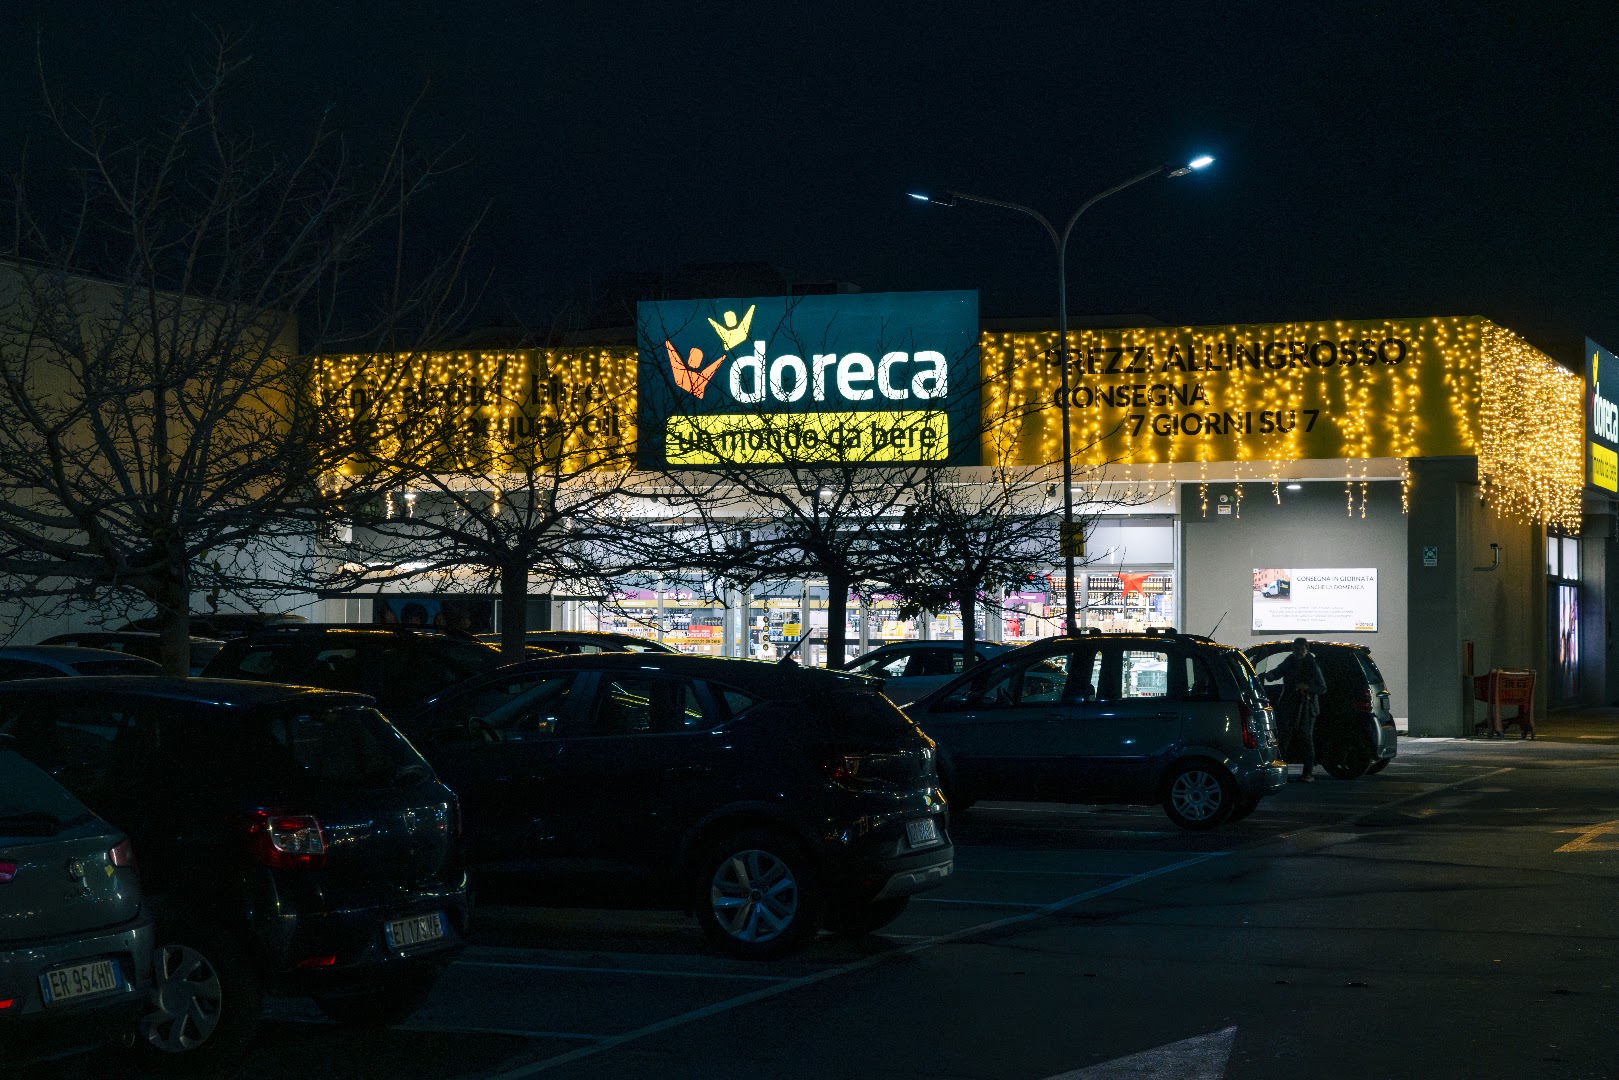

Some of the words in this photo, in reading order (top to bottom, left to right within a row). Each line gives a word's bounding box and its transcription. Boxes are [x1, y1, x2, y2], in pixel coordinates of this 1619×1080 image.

[729, 341, 948, 403] doreca
[1044, 346, 1154, 375] PREZZI
[1161, 338, 1407, 373] ALL'INGROSSO
[1054, 384, 1211, 408] CONSEGNA
[1129, 414, 1145, 437] 7
[1152, 410, 1252, 437] GIORNI
[1259, 410, 1296, 434] SU
[1303, 409, 1320, 433] 7
[1594, 382, 1619, 443] doreca
[721, 421, 819, 451] mondo
[828, 420, 861, 449] da
[871, 420, 937, 449] bere
[50, 971, 70, 998] ER
